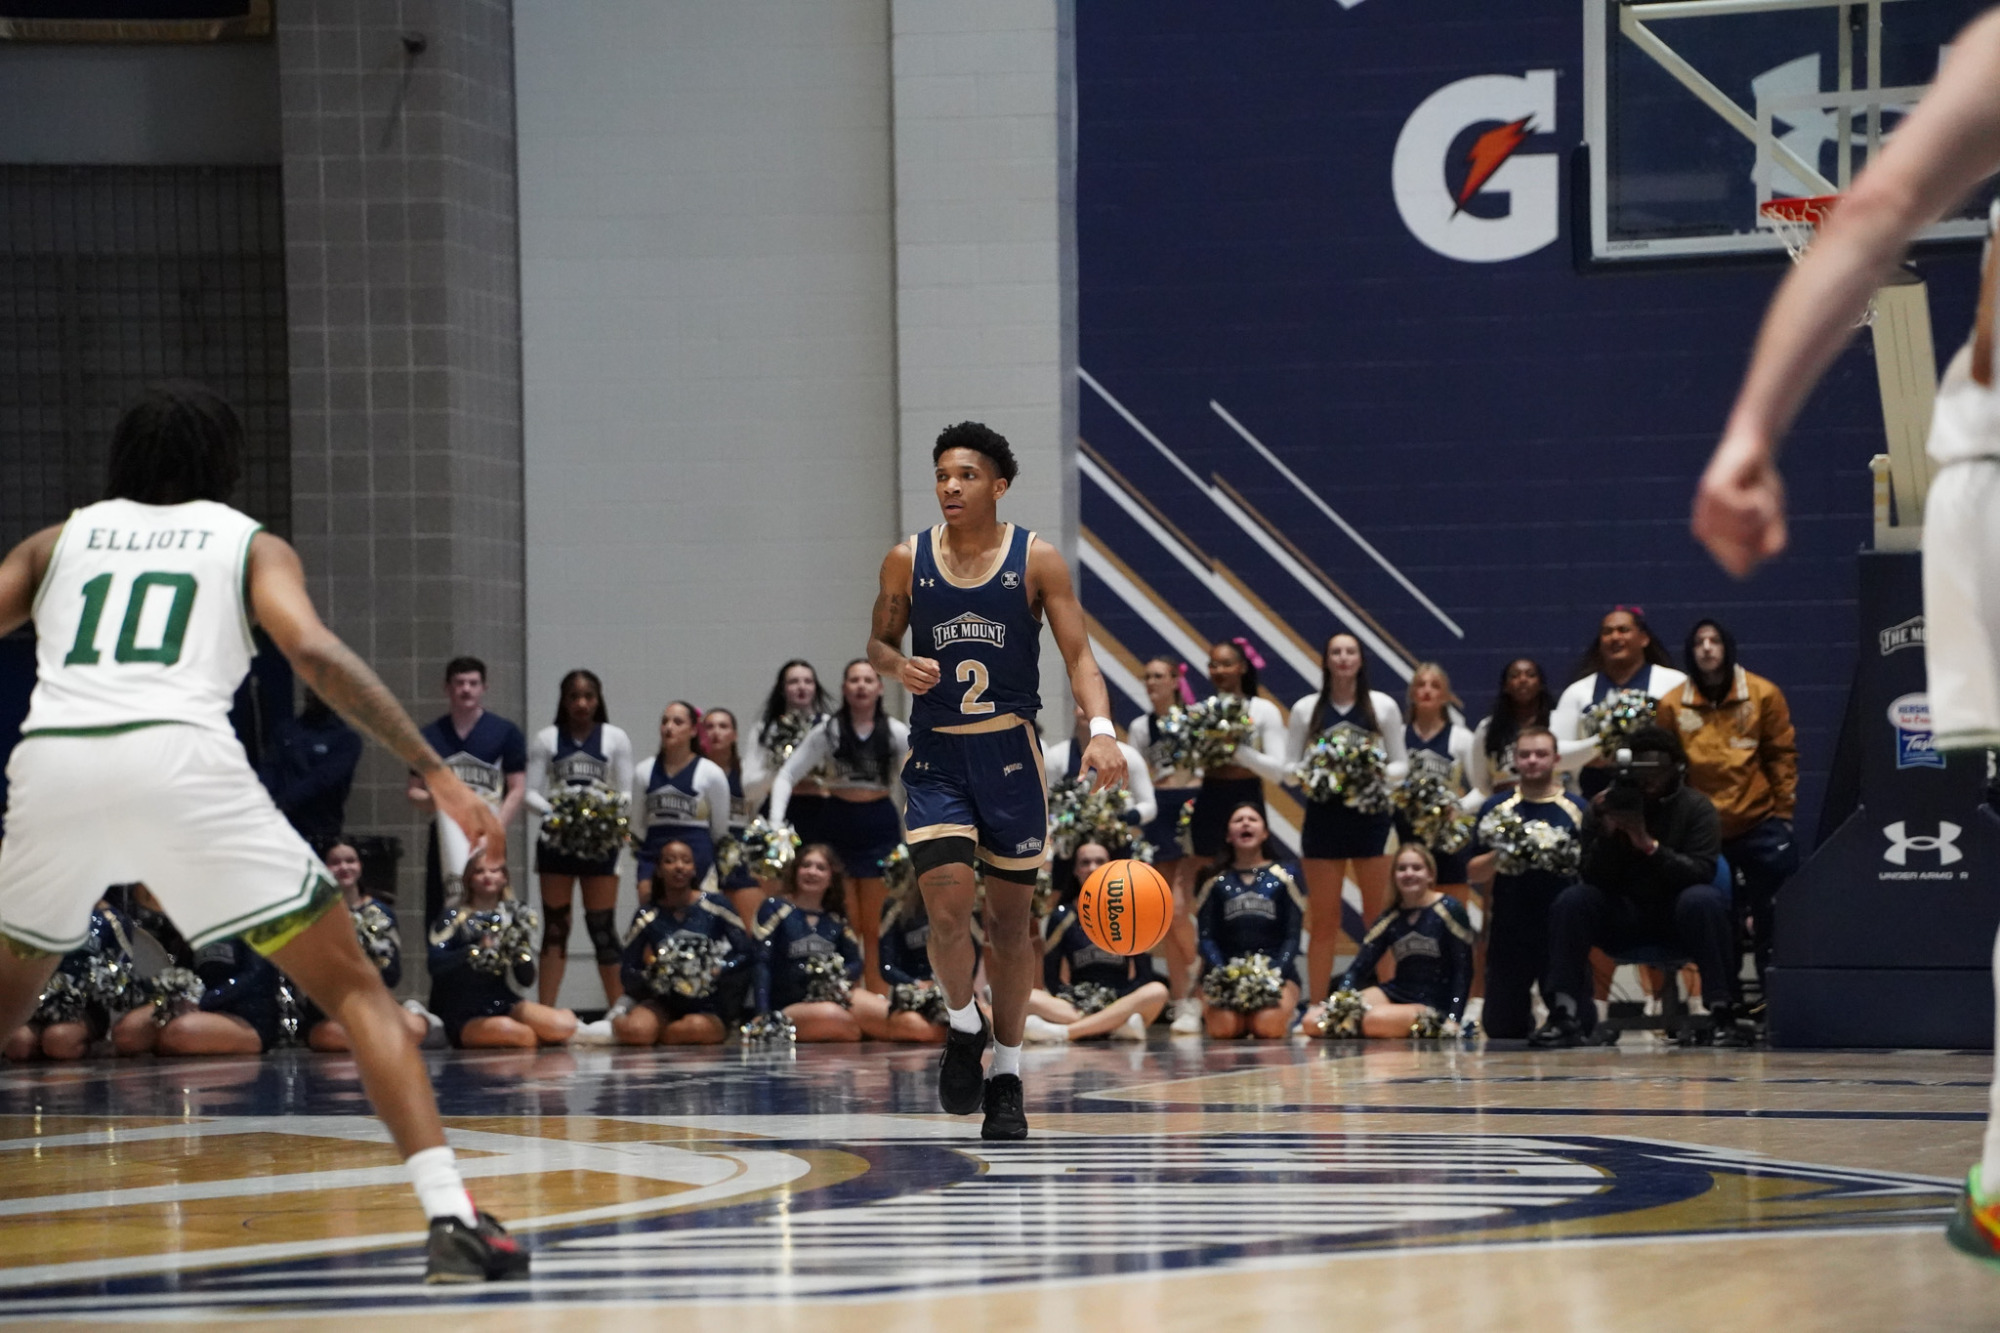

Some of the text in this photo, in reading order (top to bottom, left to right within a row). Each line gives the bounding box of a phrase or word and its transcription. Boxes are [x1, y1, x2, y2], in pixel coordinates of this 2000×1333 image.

[1391, 69, 1559, 263] G
[86, 528, 214, 551] ELLIOTT
[64, 571, 197, 668] 10
[935, 623, 1003, 645] THE MOUNT
[1883, 628, 1909, 650] THE
[956, 659, 995, 714] 2
[1878, 871, 1969, 881] UNDER ARMOR
[1106, 878, 1124, 942] Wilson
